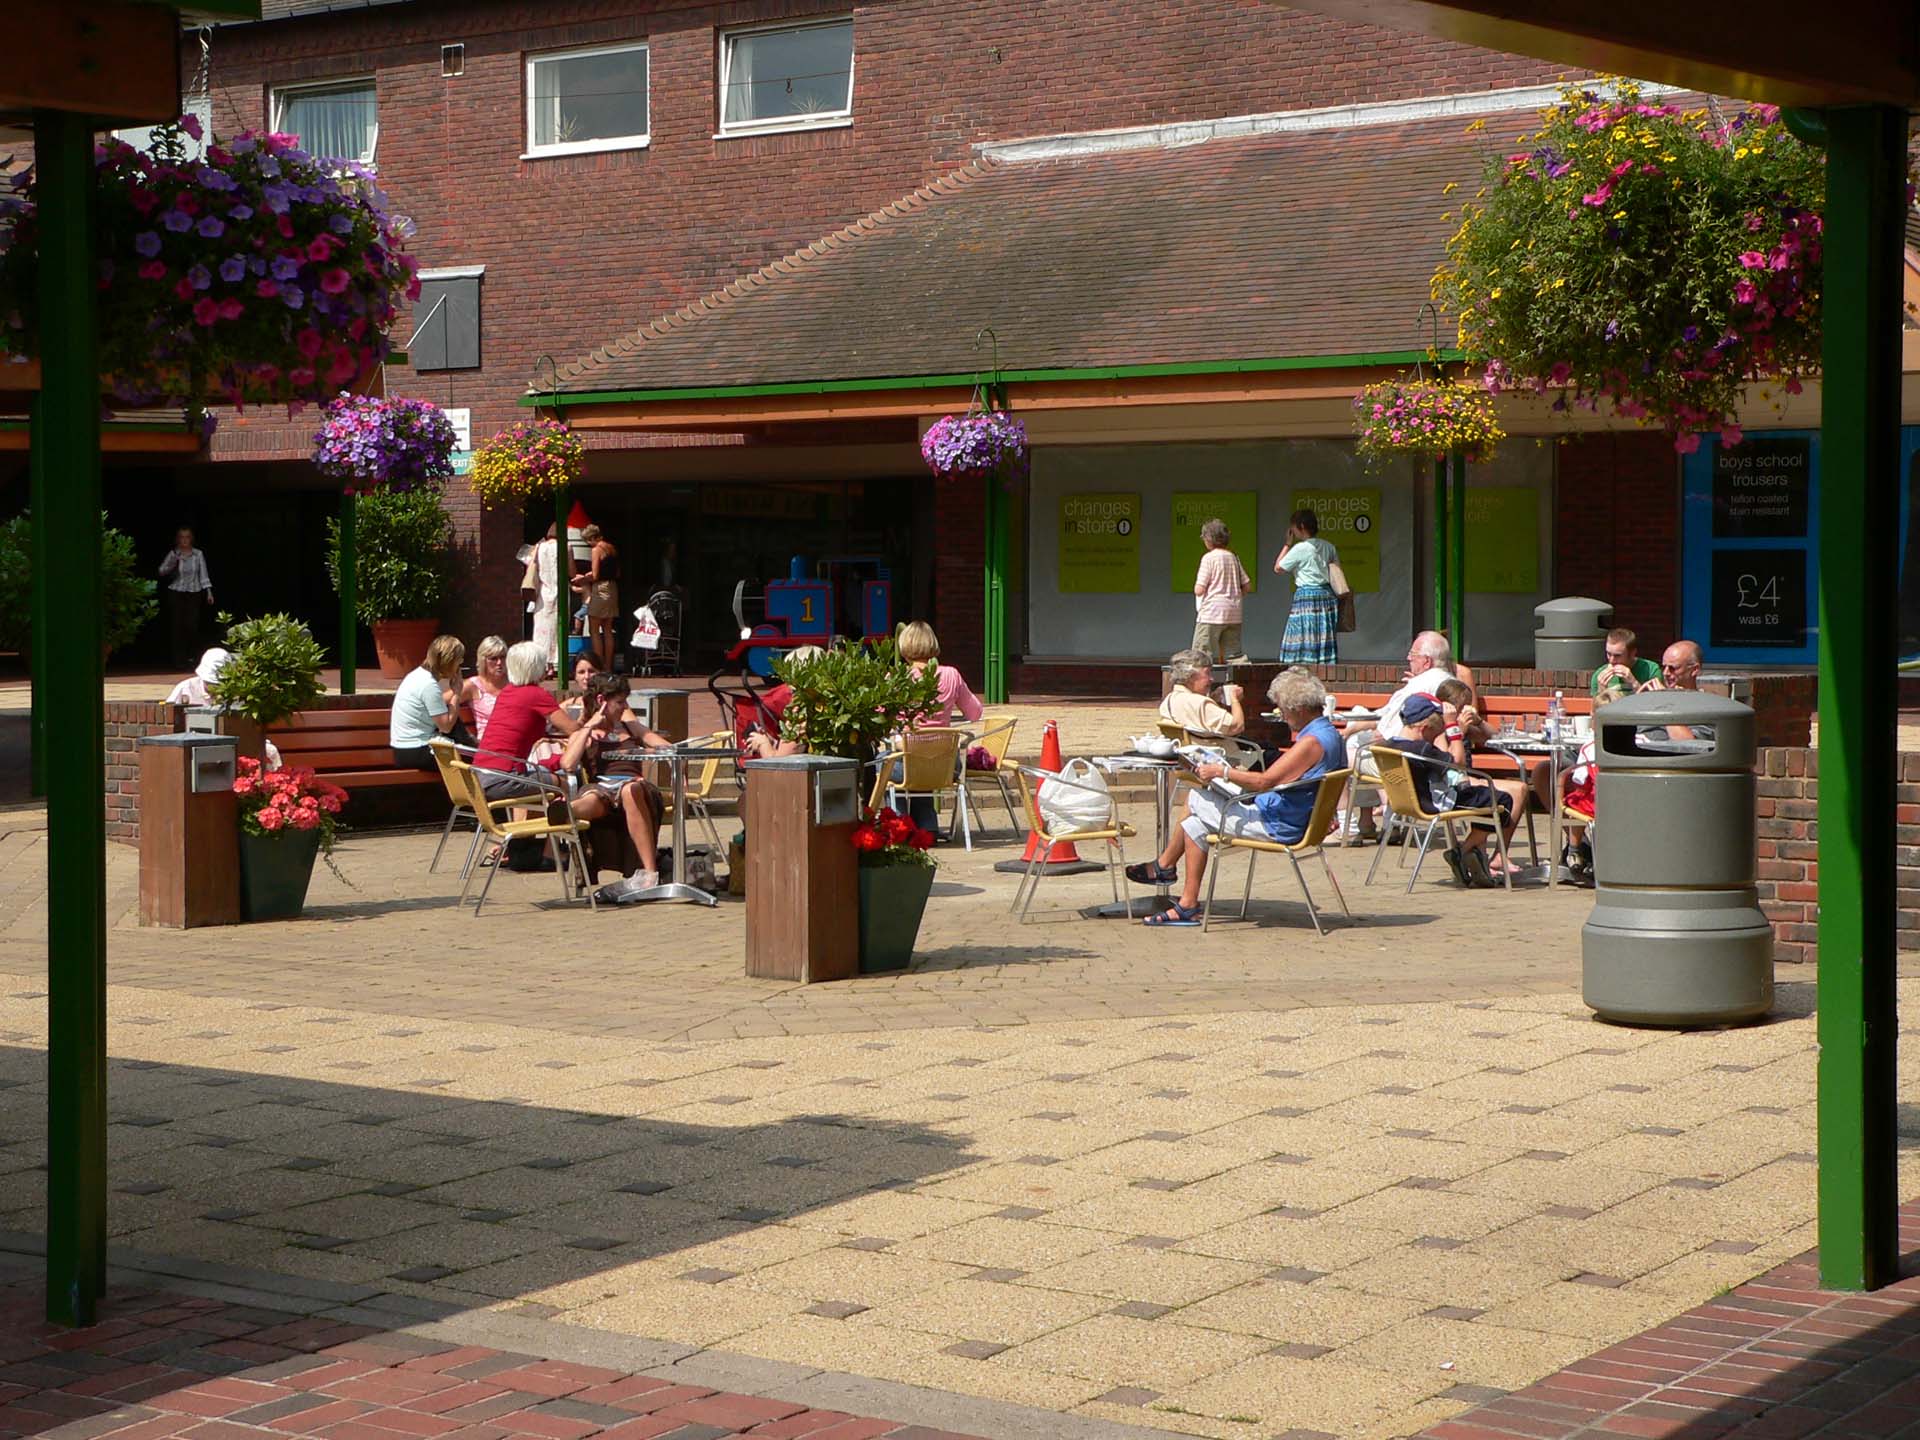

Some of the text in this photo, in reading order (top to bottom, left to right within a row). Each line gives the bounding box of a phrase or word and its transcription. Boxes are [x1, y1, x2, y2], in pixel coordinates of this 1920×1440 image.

[1720, 452, 1802, 470] boys school
[1732, 474, 1788, 487] trousers
[1064, 498, 1130, 519] changes
[1297, 496, 1370, 516] changes
[801, 596, 815, 622] 1
[1738, 613, 1779, 625] was £6
